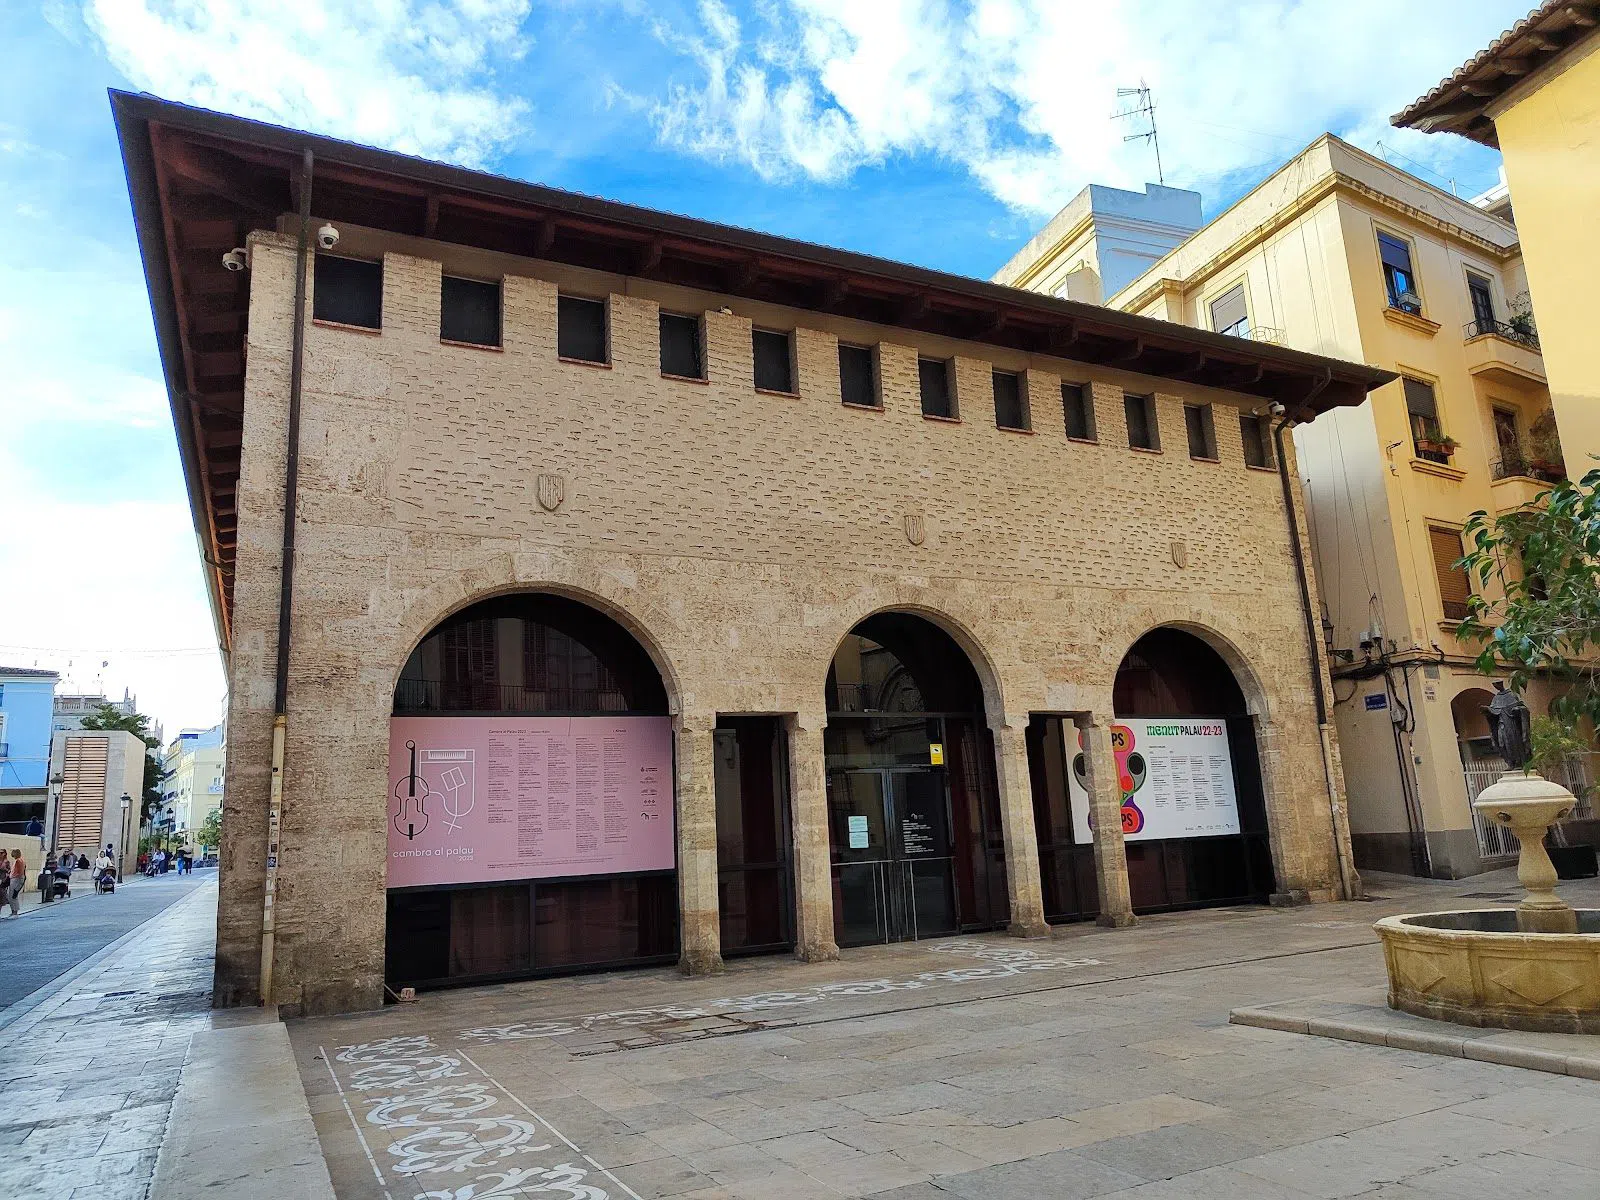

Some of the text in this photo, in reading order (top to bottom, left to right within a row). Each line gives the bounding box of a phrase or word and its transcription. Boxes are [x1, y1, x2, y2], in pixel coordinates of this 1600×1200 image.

[1180, 725, 1202, 736] PALAU
[1202, 725, 1223, 736] 22-23
[392, 845, 474, 858] cambra al palau
